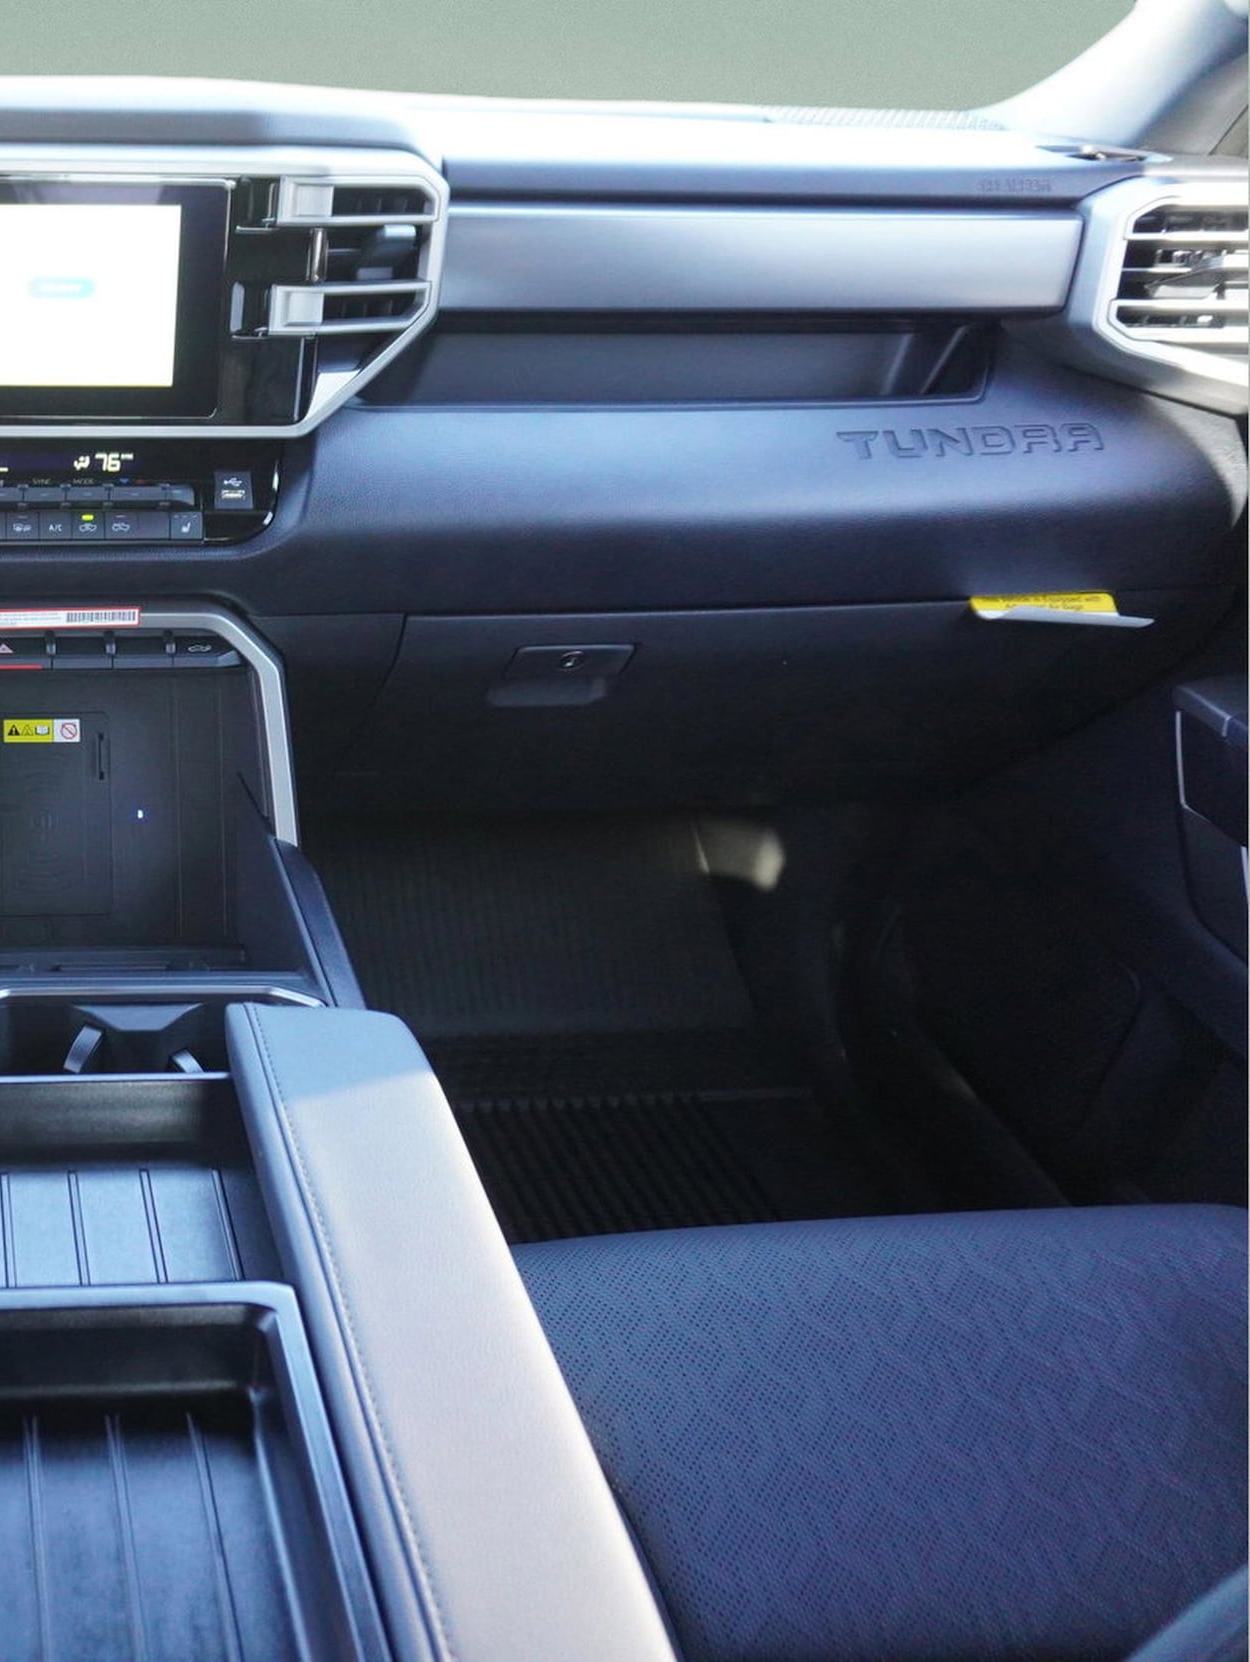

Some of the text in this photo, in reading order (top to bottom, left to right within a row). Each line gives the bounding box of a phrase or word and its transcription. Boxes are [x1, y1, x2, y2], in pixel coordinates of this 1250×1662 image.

[836, 422, 1105, 460] TUNDRA
[95, 453, 121, 472] 76
[32, 478, 51, 486] SYNC
[73, 477, 95, 486] MODE
[48, 523, 63, 533] A/C
